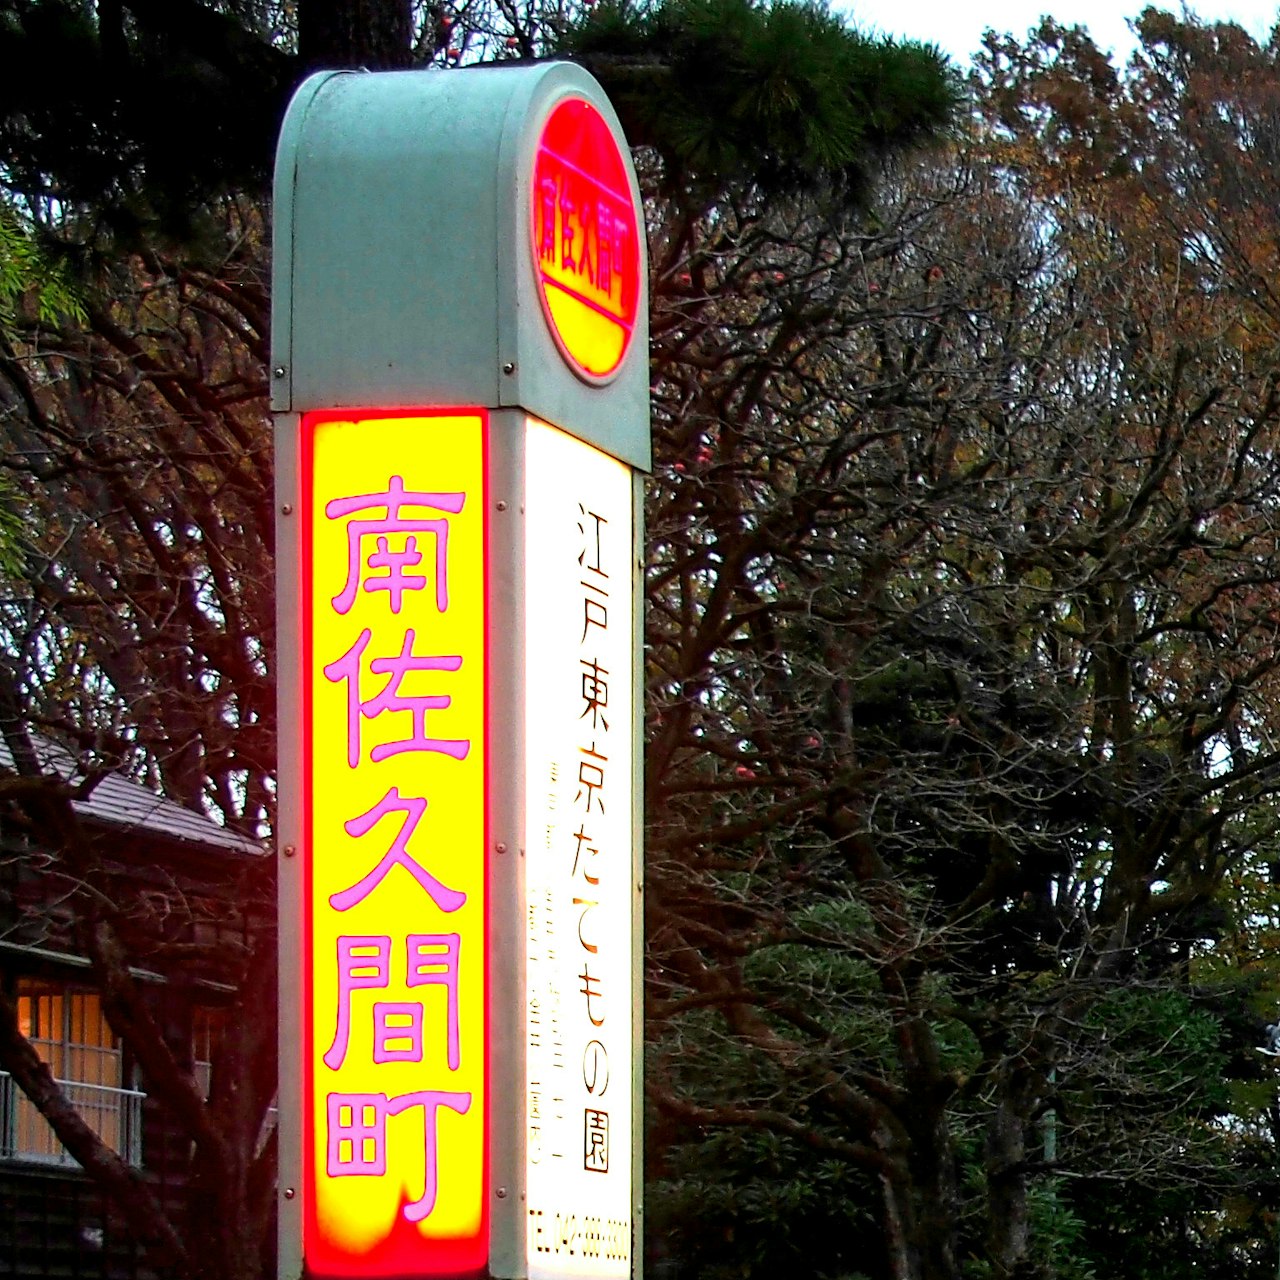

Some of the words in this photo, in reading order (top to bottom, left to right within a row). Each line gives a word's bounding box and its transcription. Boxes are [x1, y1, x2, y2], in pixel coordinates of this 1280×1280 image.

[322, 475, 472, 1222] 南佐久間町
[572, 501, 610, 1175] 江戸東京たてもの園
